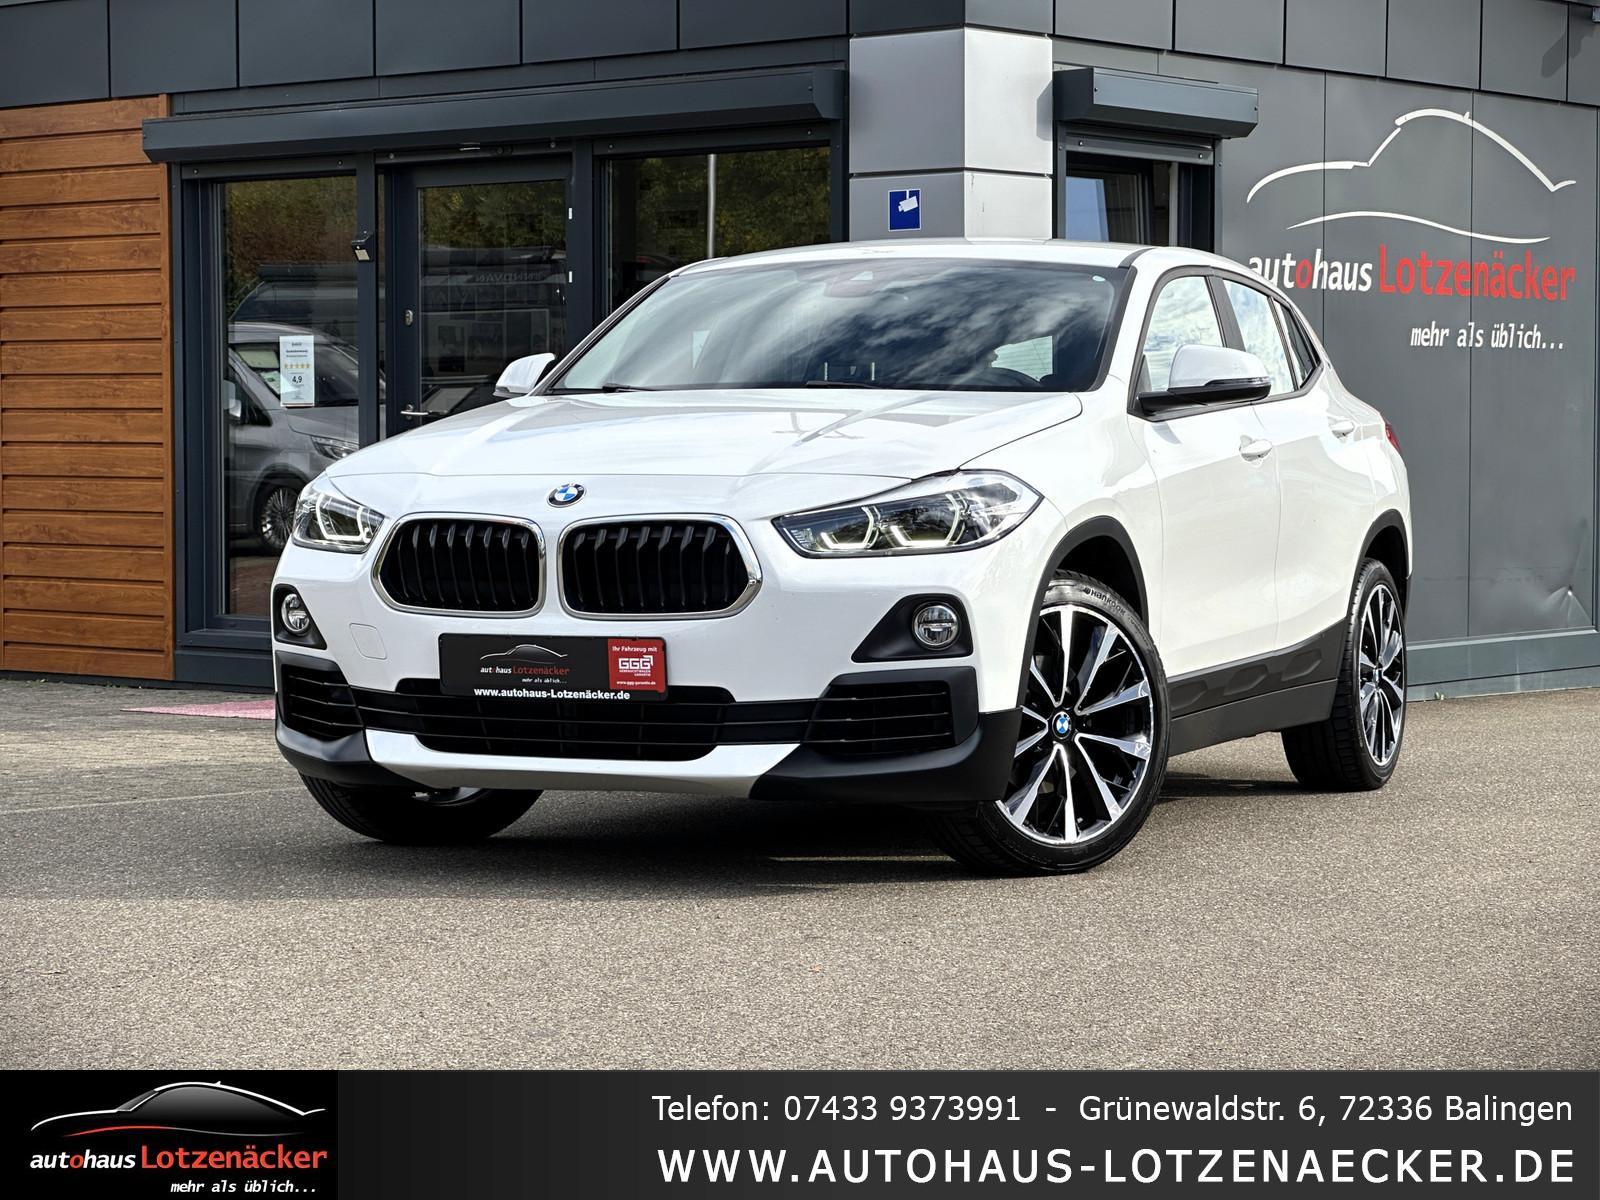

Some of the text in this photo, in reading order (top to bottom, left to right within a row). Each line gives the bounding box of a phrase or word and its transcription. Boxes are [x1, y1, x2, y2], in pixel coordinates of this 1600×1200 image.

[1248, 244, 1576, 301] autohaus Lotzenäcker
[1410, 321, 1563, 349] mehr als üblich...
[292, 376, 303, 384] 4,9
[474, 688, 630, 700] www.autohaus-Lotzenäcker.de
